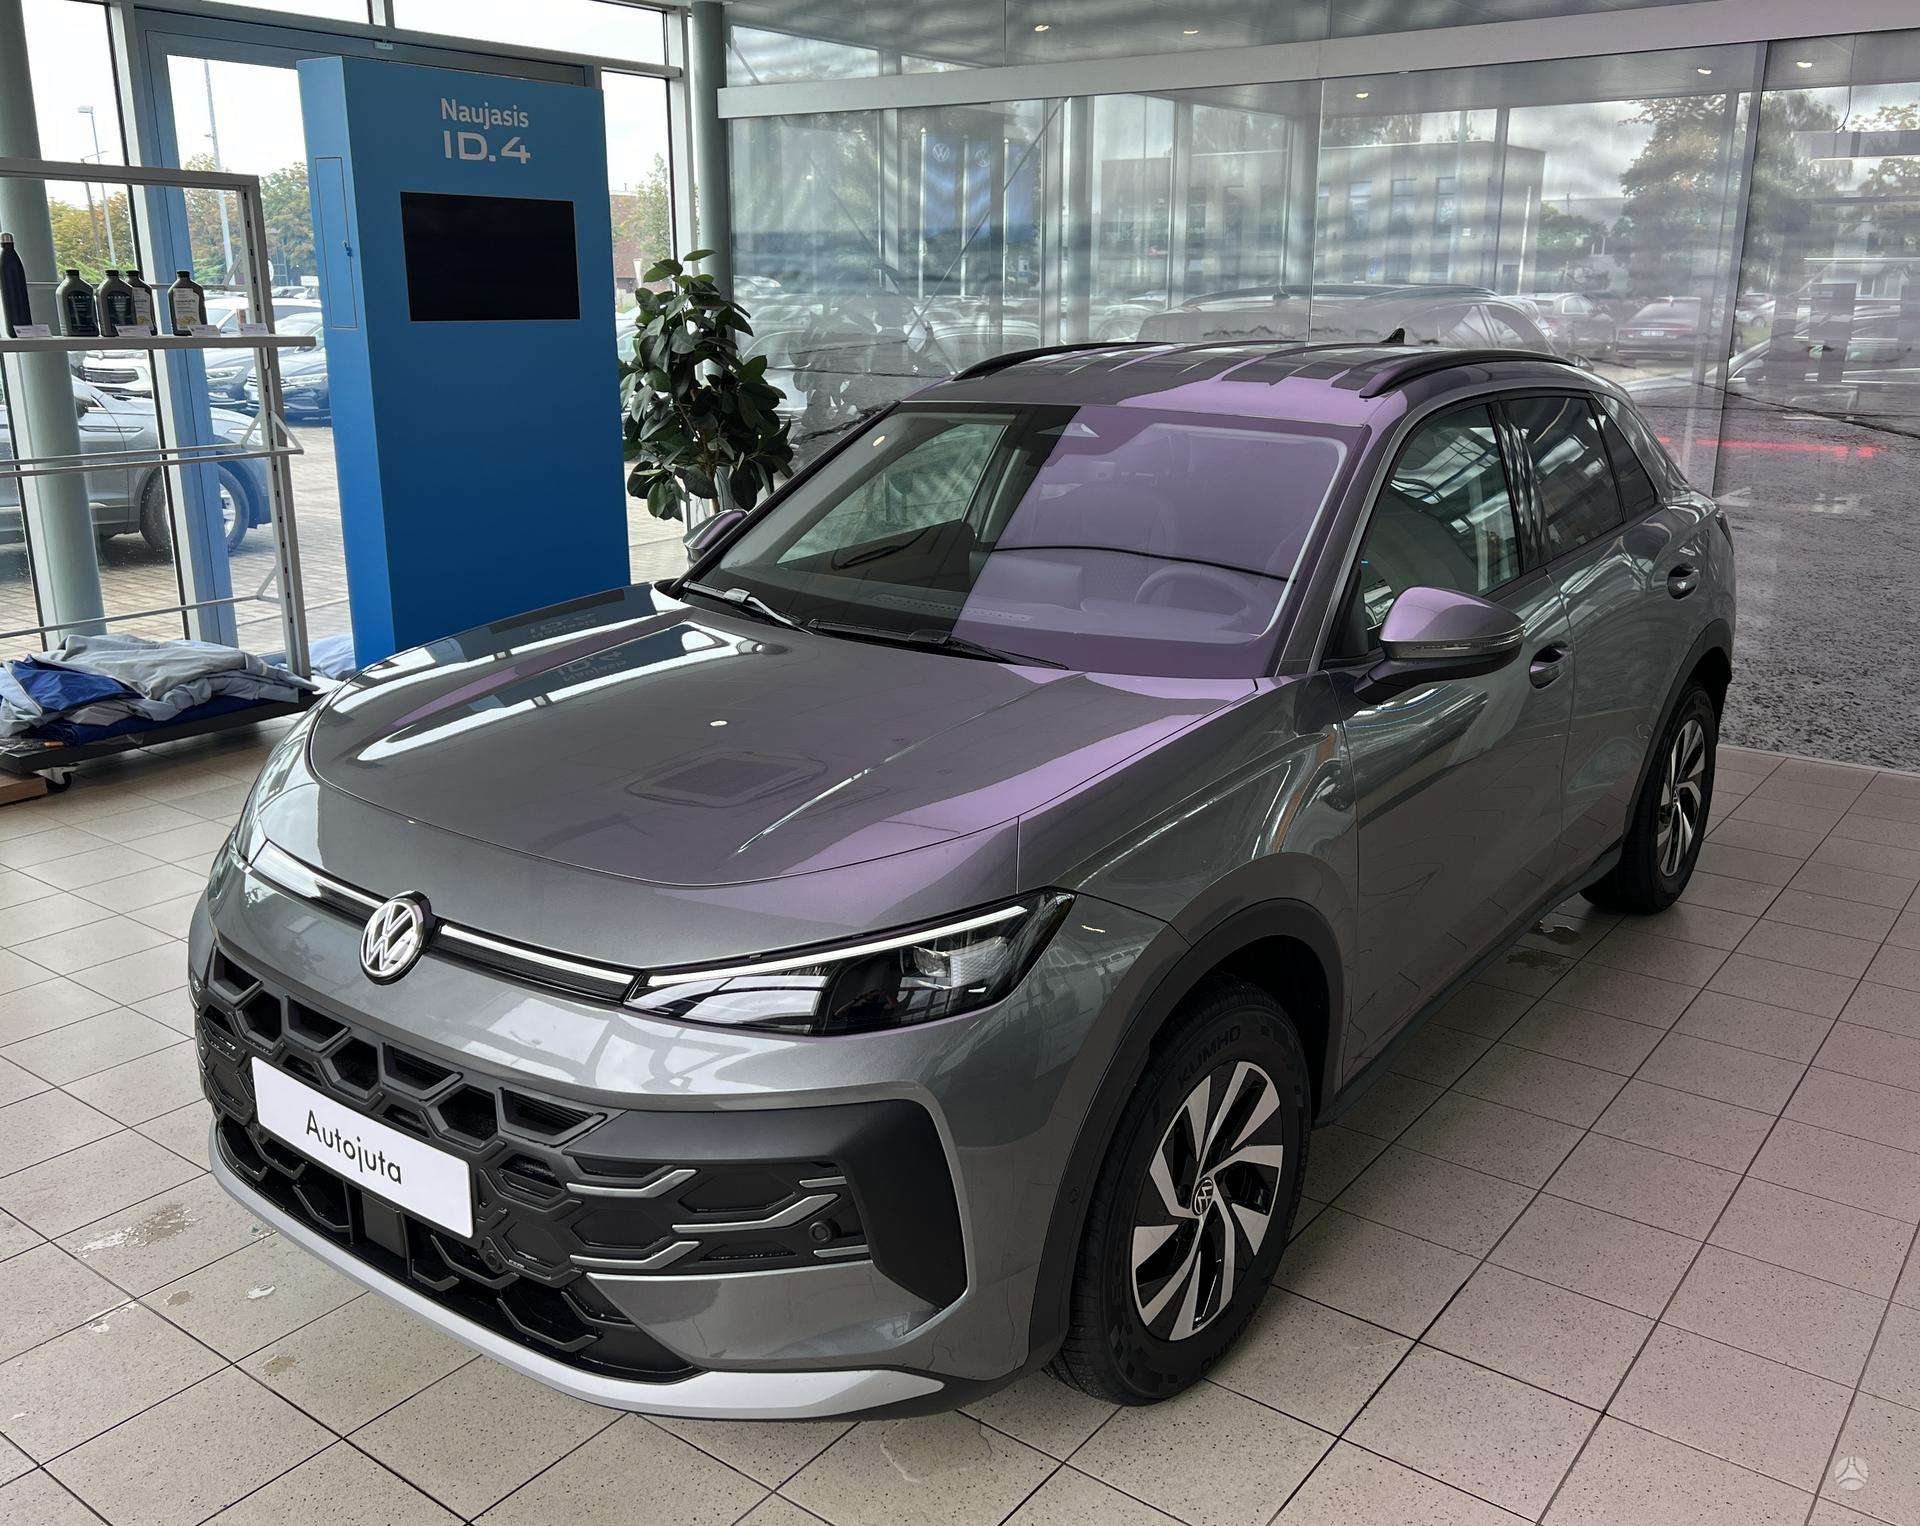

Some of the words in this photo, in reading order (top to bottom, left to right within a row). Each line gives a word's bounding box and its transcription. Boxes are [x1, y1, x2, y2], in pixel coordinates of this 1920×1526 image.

[441, 98, 529, 129] Naujasis
[443, 130, 531, 164] ID.4
[306, 1109, 401, 1185] Autojuta
